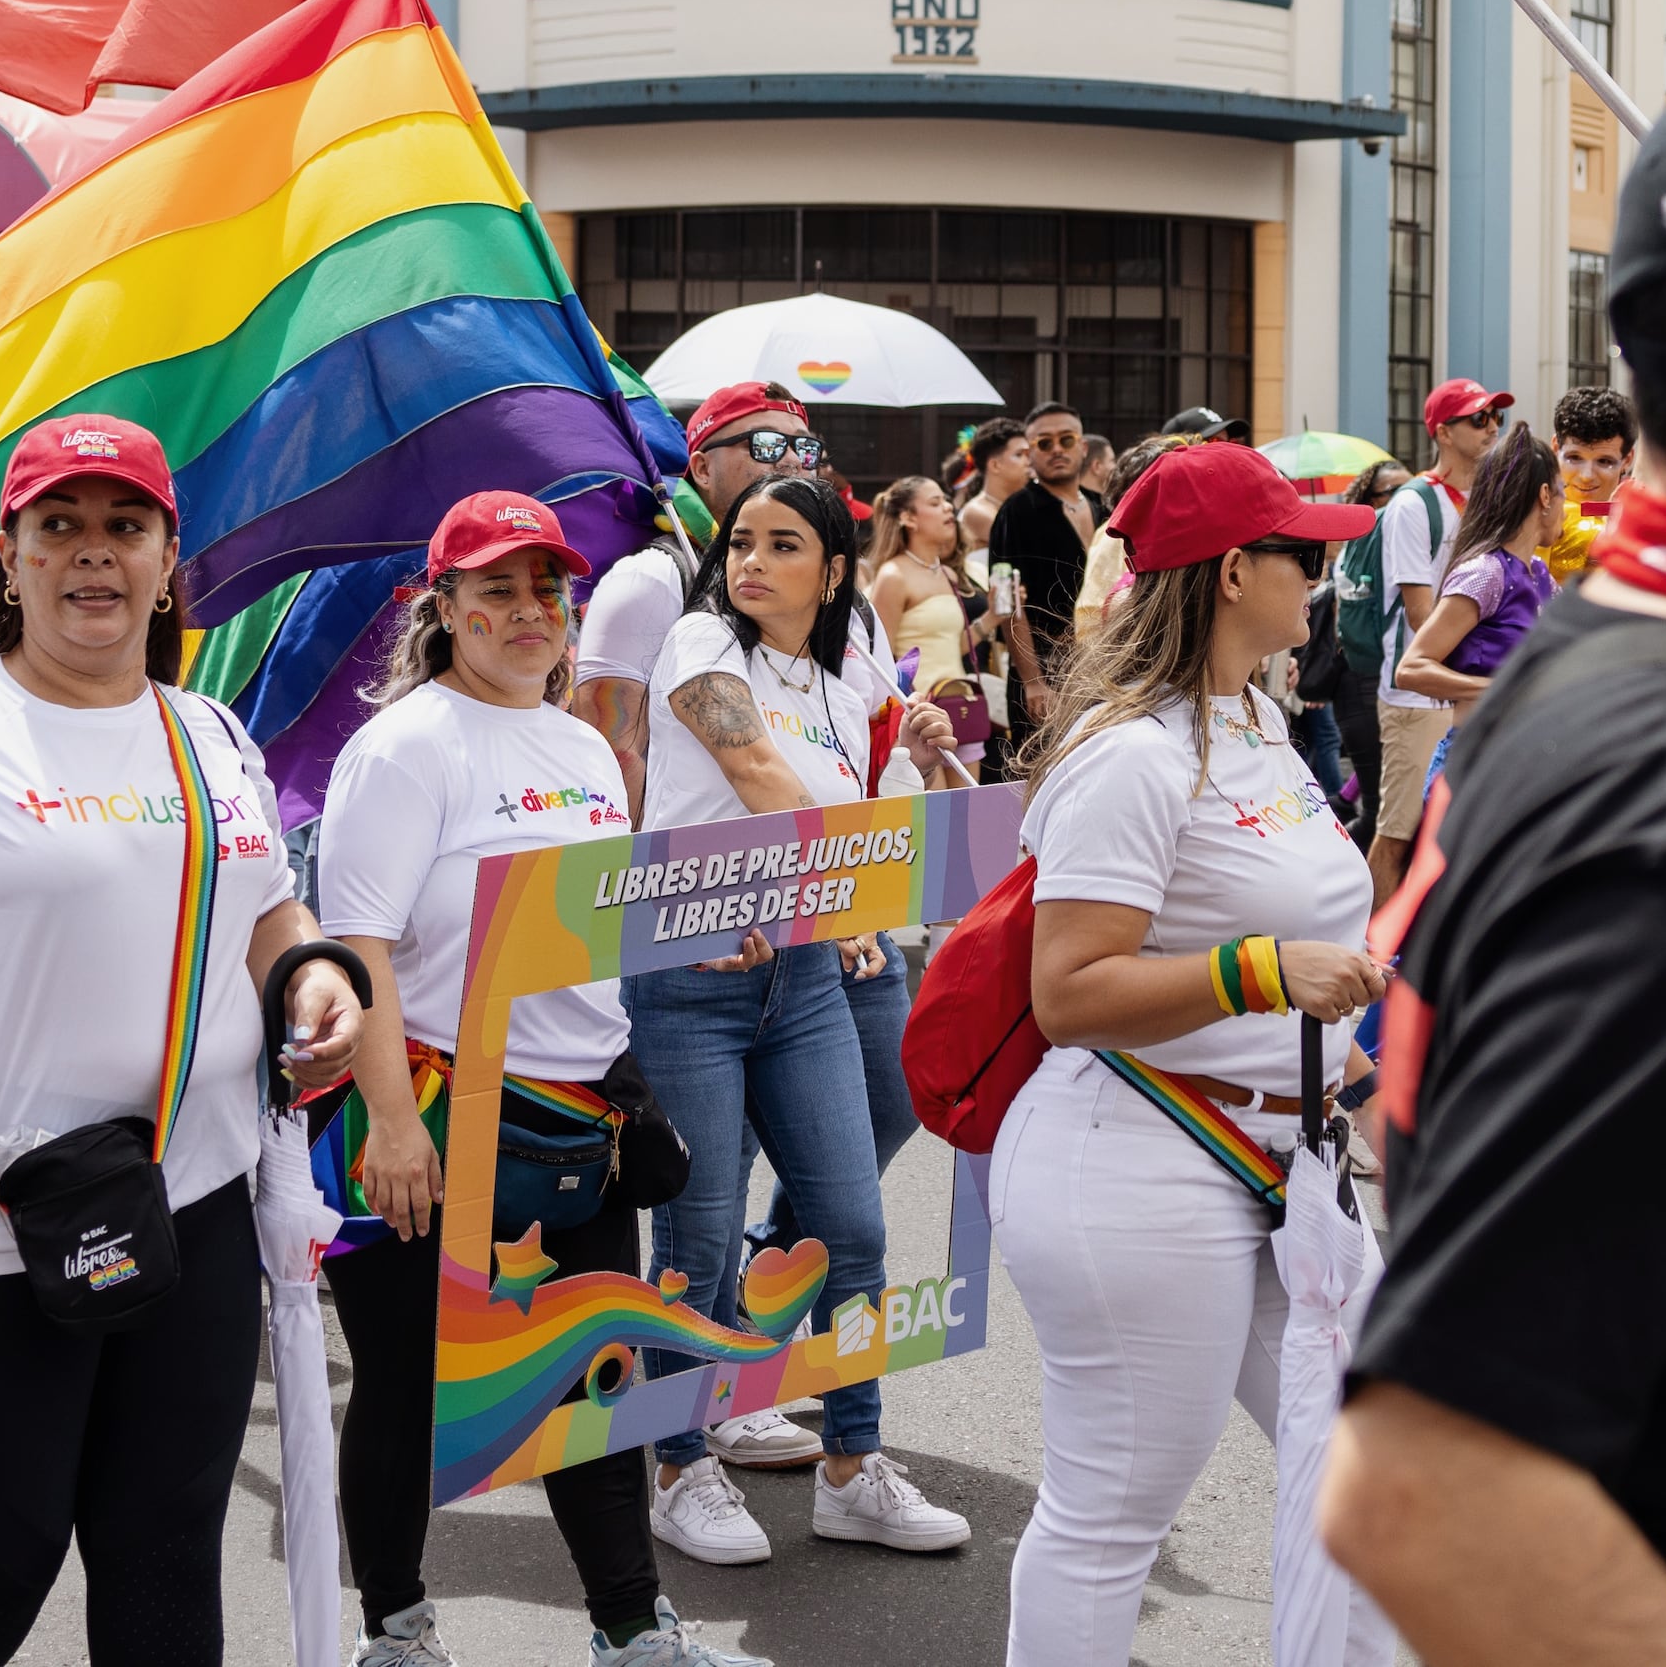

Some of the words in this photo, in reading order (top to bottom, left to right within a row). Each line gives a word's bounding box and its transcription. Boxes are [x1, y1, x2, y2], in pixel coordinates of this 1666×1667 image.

[895, 25, 975, 55] 1932
[235, 834, 270, 853] BAC
[594, 857, 701, 909] LIBRES
[701, 850, 745, 890] DE
[744, 826, 918, 882] PREJUICIOS,
[653, 891, 758, 943] LIBRES
[758, 885, 801, 924] DE
[800, 877, 856, 917] SER
[64, 1246, 117, 1280] libres
[89, 1258, 141, 1291] SER
[885, 1278, 967, 1344] BAC
